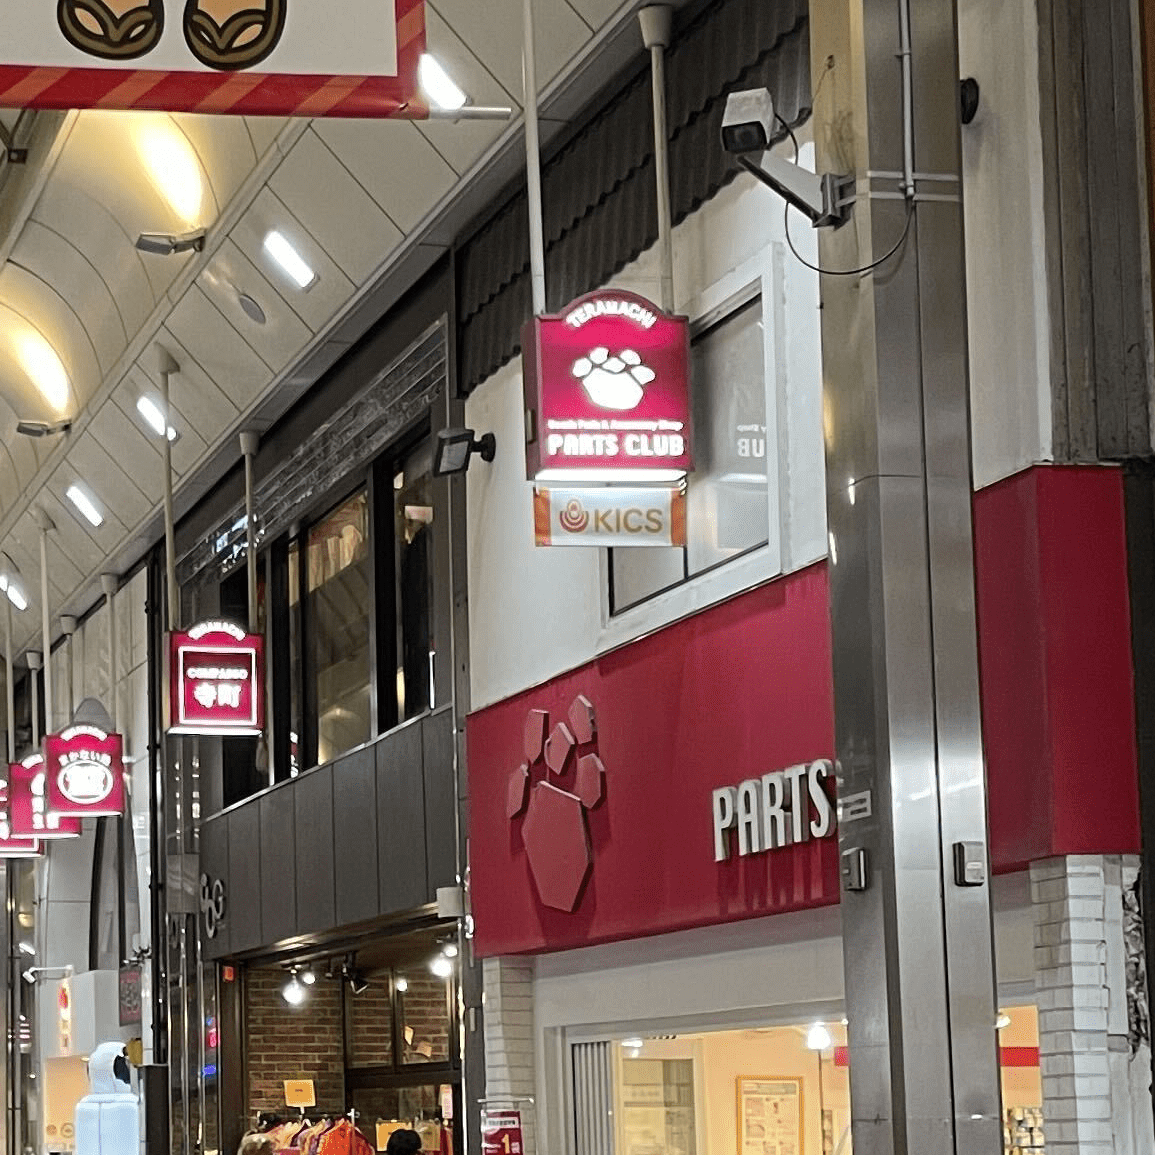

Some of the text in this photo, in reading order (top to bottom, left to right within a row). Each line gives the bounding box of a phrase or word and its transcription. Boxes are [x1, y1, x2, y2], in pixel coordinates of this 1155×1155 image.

[565, 300, 657, 329] TERAMACHI
[547, 433, 685, 457] PARTS CLUB
[594, 508, 664, 534] KICS
[713, 758, 833, 862] PARTS
